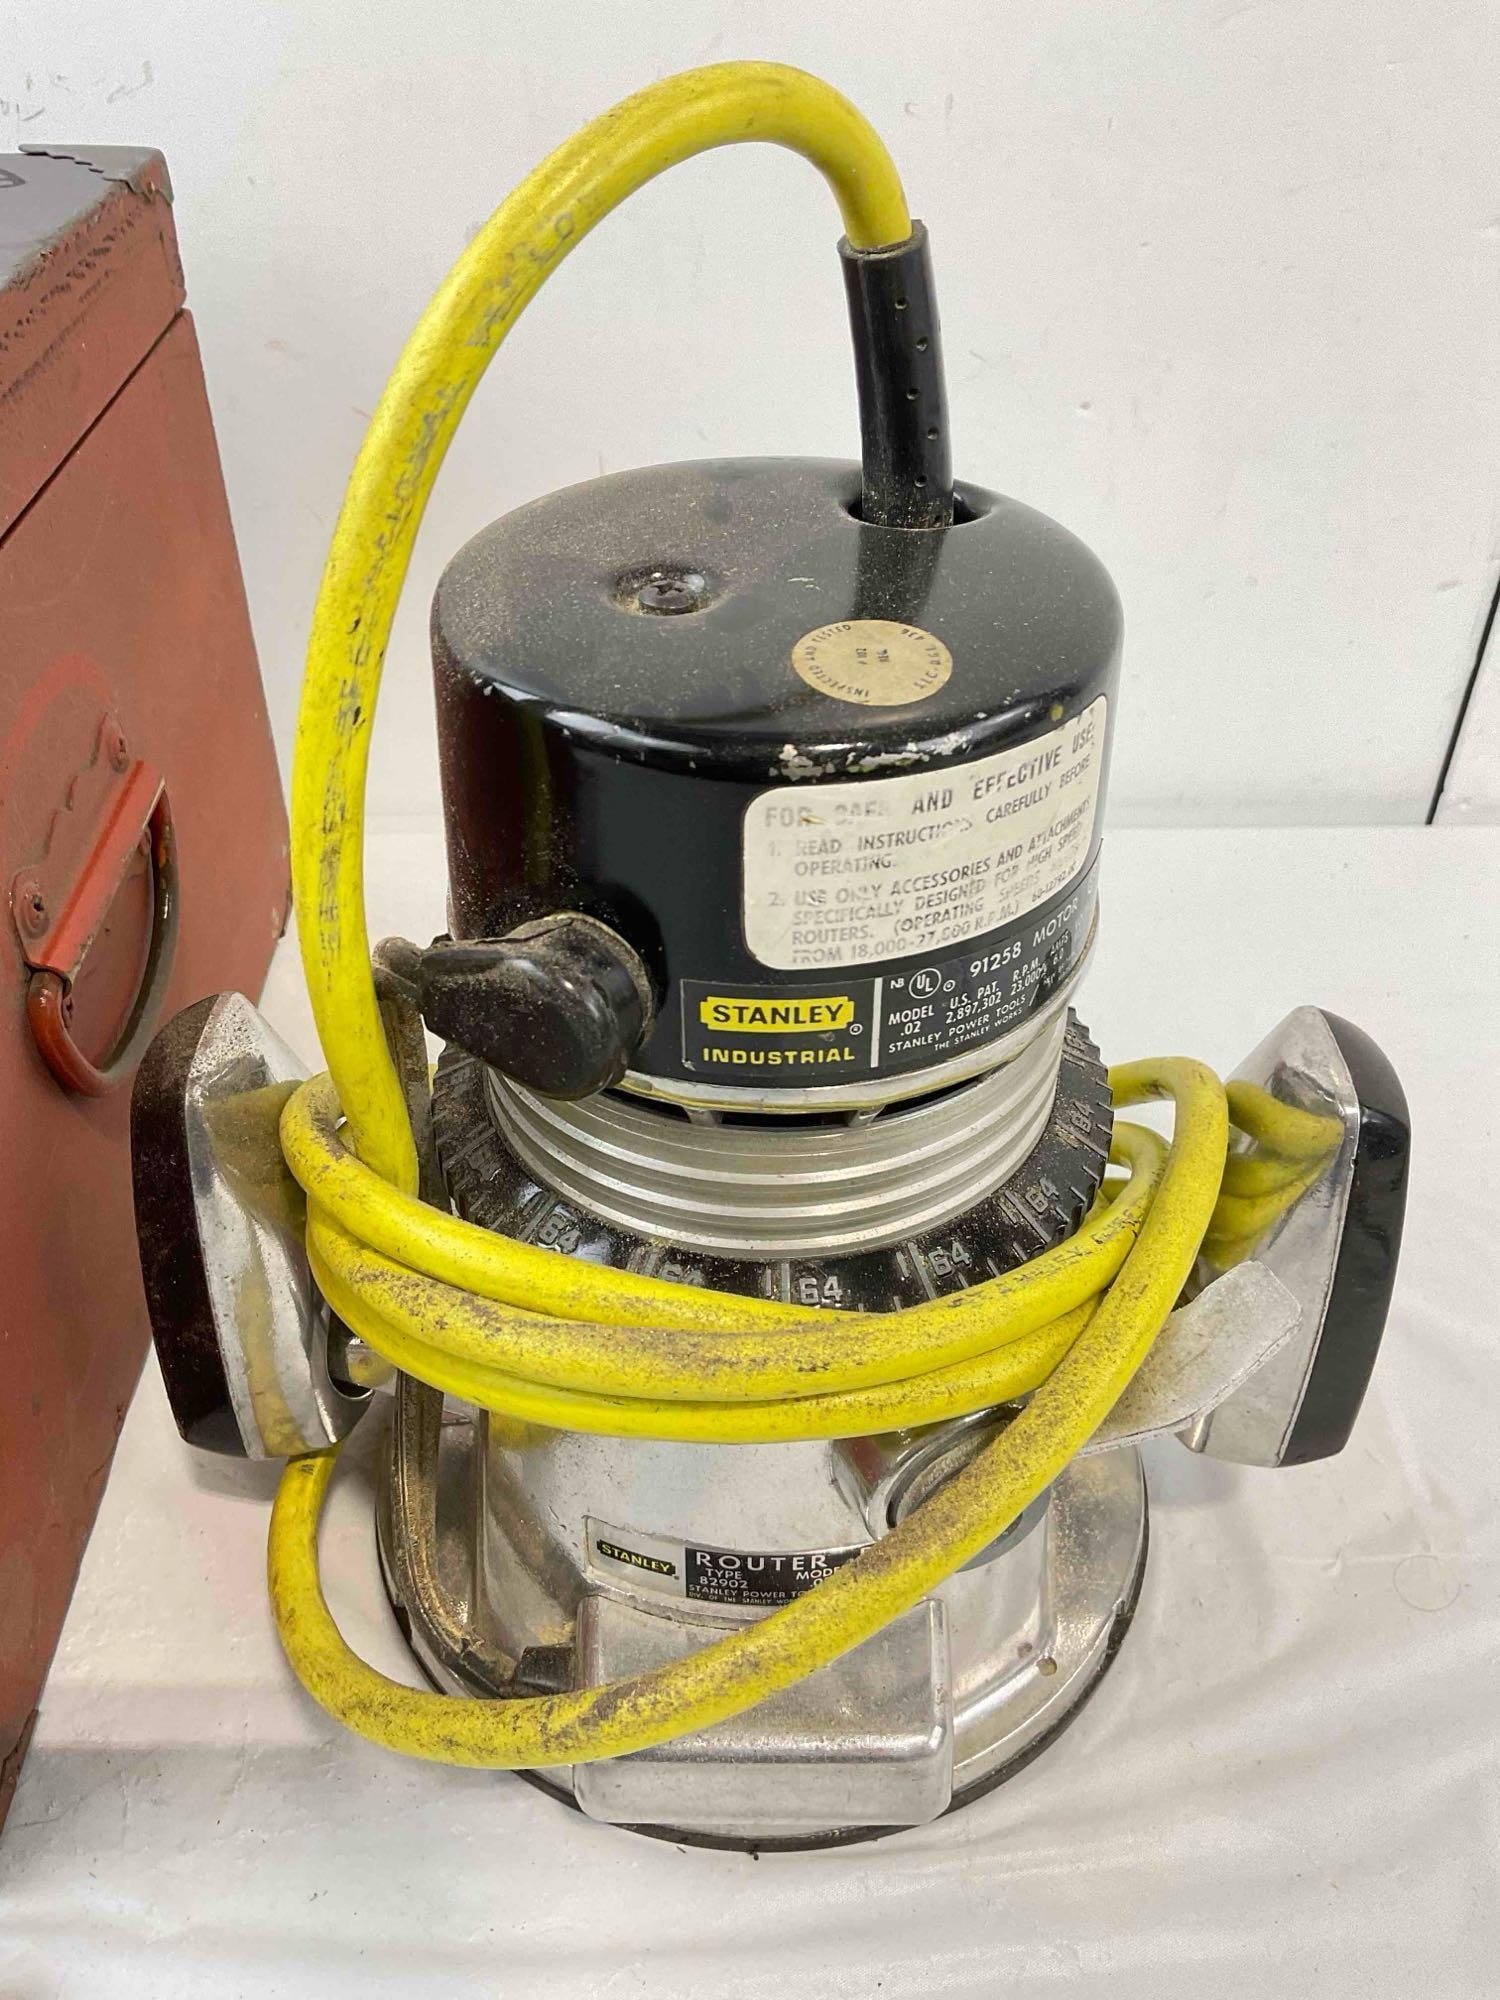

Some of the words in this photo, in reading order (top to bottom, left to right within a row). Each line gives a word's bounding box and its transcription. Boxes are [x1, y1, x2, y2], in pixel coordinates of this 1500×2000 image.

[812, 624, 852, 643] TESTED
[765, 805, 815, 827] FOR
[912, 787, 953, 815] AND
[972, 744, 1064, 802] EFFECTIVE
[985, 780, 1053, 824] CAREFULLY
[1059, 753, 1092, 790] BEFORE
[890, 857, 992, 896] ACCESSORIES
[996, 844, 1024, 869] AND
[793, 899, 904, 926] SPECIFICALLY
[914, 880, 985, 911] DESIGNED
[792, 925, 875, 946] ROUTERS.
[969, 940, 1023, 979] 91258
[1032, 897, 1079, 948] MOTOR
[792, 947, 843, 965] FROM
[888, 1004, 935, 1027] MODEL
[949, 993, 971, 1010] U.S.
[978, 980, 1000, 999] PAT.
[1012, 956, 1040, 982] R.P.M.
[713, 1004, 844, 1025] STANLEY
[888, 1032, 942, 1053] STANLEY
[948, 1014, 990, 1038] POWER
[995, 994, 1027, 1019] TOOLS
[899, 1020, 922, 1037] .02
[945, 991, 1001, 1025] 2,897,302
[934, 1041, 950, 1051] THE
[954, 1025, 990, 1046] STANLEY
[994, 1008, 1023, 1028] WORKS
[702, 1048, 856, 1065] INDUSTRIAL
[1024, 1176, 1060, 1215] 64
[927, 1239, 973, 1277] 64
[799, 1275, 844, 1305] 64
[601, 1543, 671, 1573] STANLEY
[695, 1551, 829, 1572] ROUTER
[704, 1567, 743, 1580] TYPE
[688, 1584, 738, 1597] STANLEY
[743, 1590, 786, 1599] POWER
[700, 1576, 749, 1589] 82902
